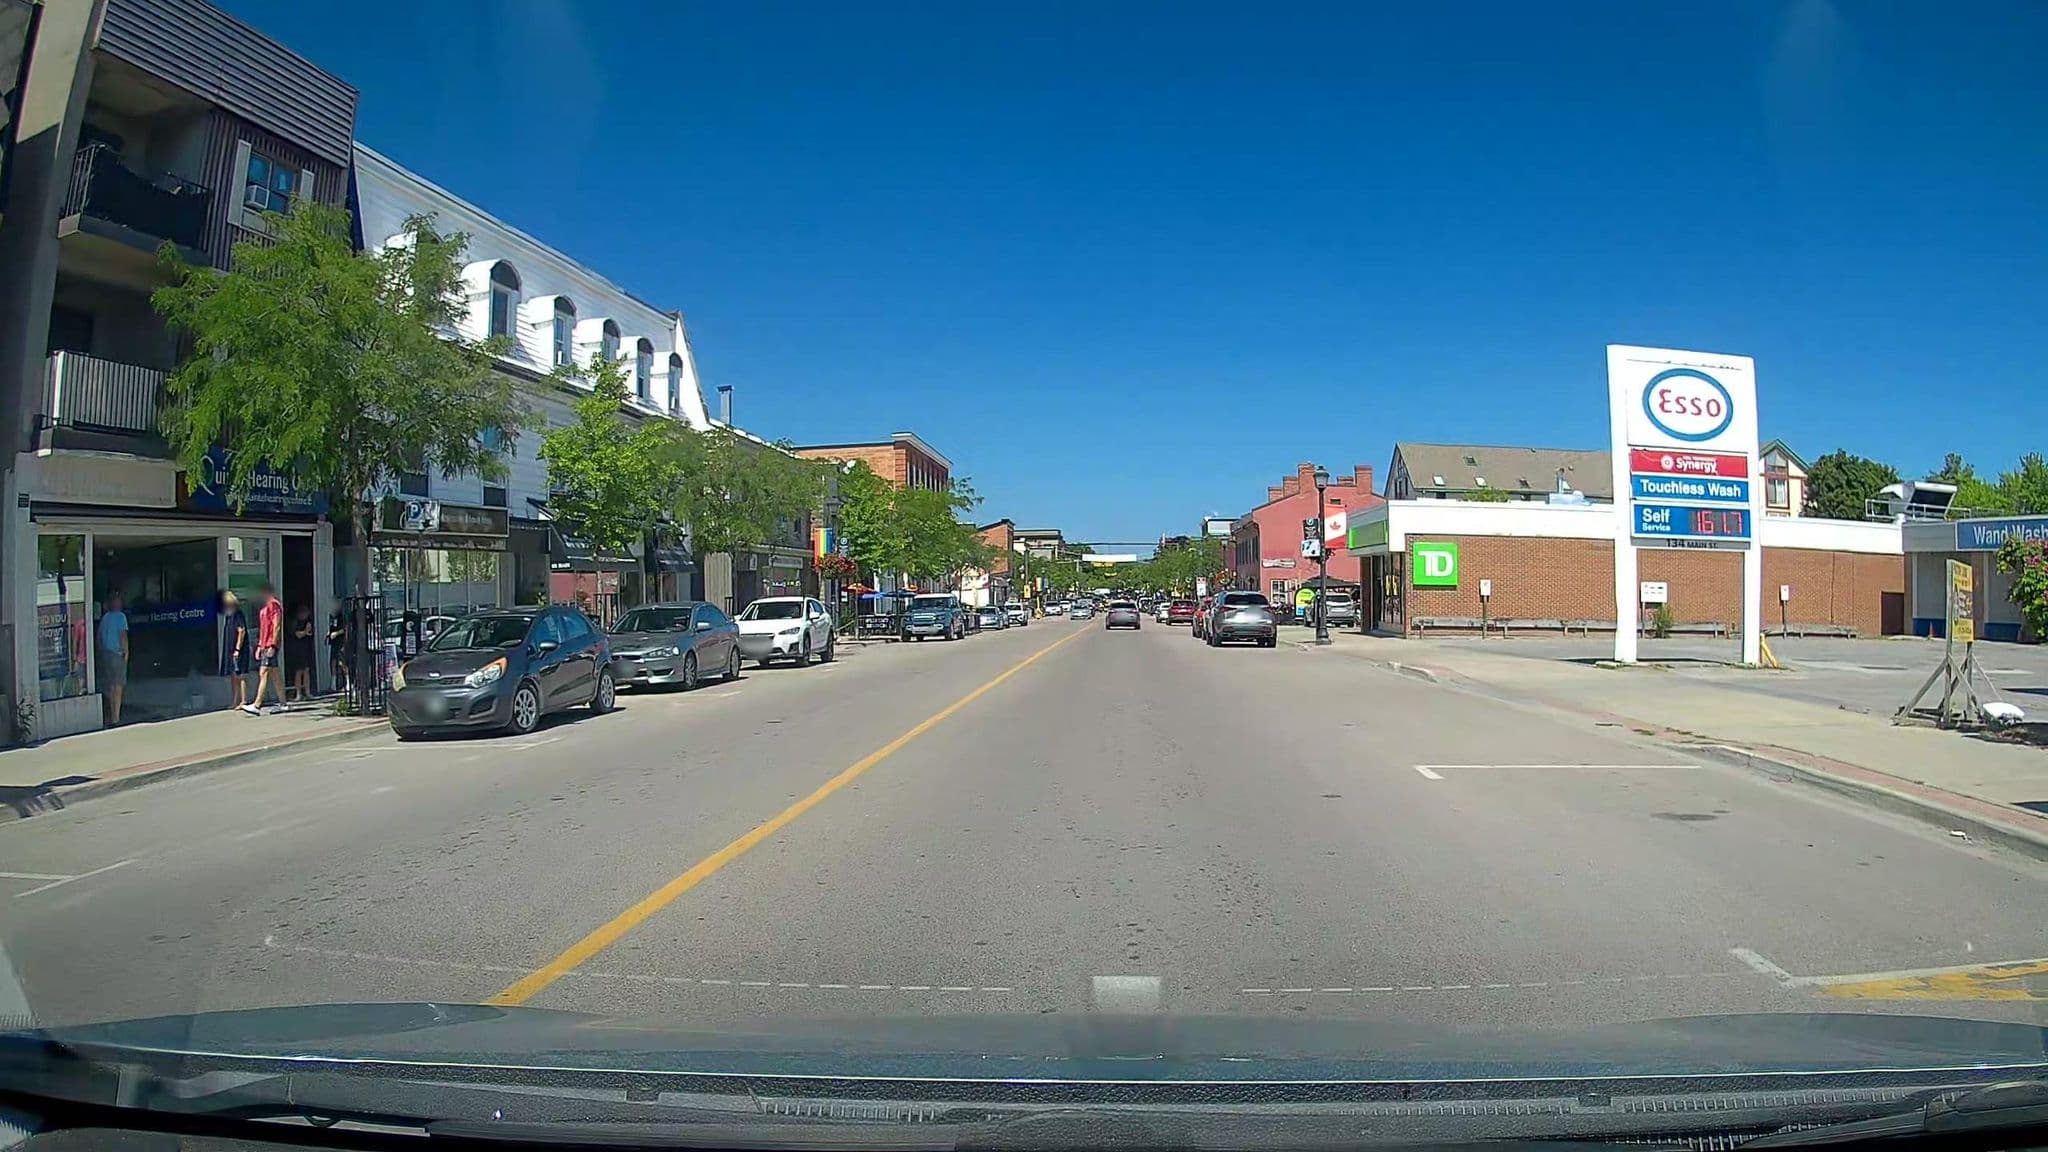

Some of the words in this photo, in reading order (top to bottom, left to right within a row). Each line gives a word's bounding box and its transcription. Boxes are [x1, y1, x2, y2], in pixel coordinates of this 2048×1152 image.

[1676, 456, 1718, 475] Synergy
[248, 469, 289, 495] Hearing
[1640, 479, 1705, 496] Touchless
[1707, 482, 1742, 498] Wash
[1642, 507, 1671, 523] Self
[1641, 523, 1671, 532] Service
[1973, 525, 2008, 545] Wand
[1666, 538, 1685, 548] 134
[1687, 541, 1707, 549] MAIN
[1417, 550, 1454, 577] TD
[180, 607, 206, 619] Centre
